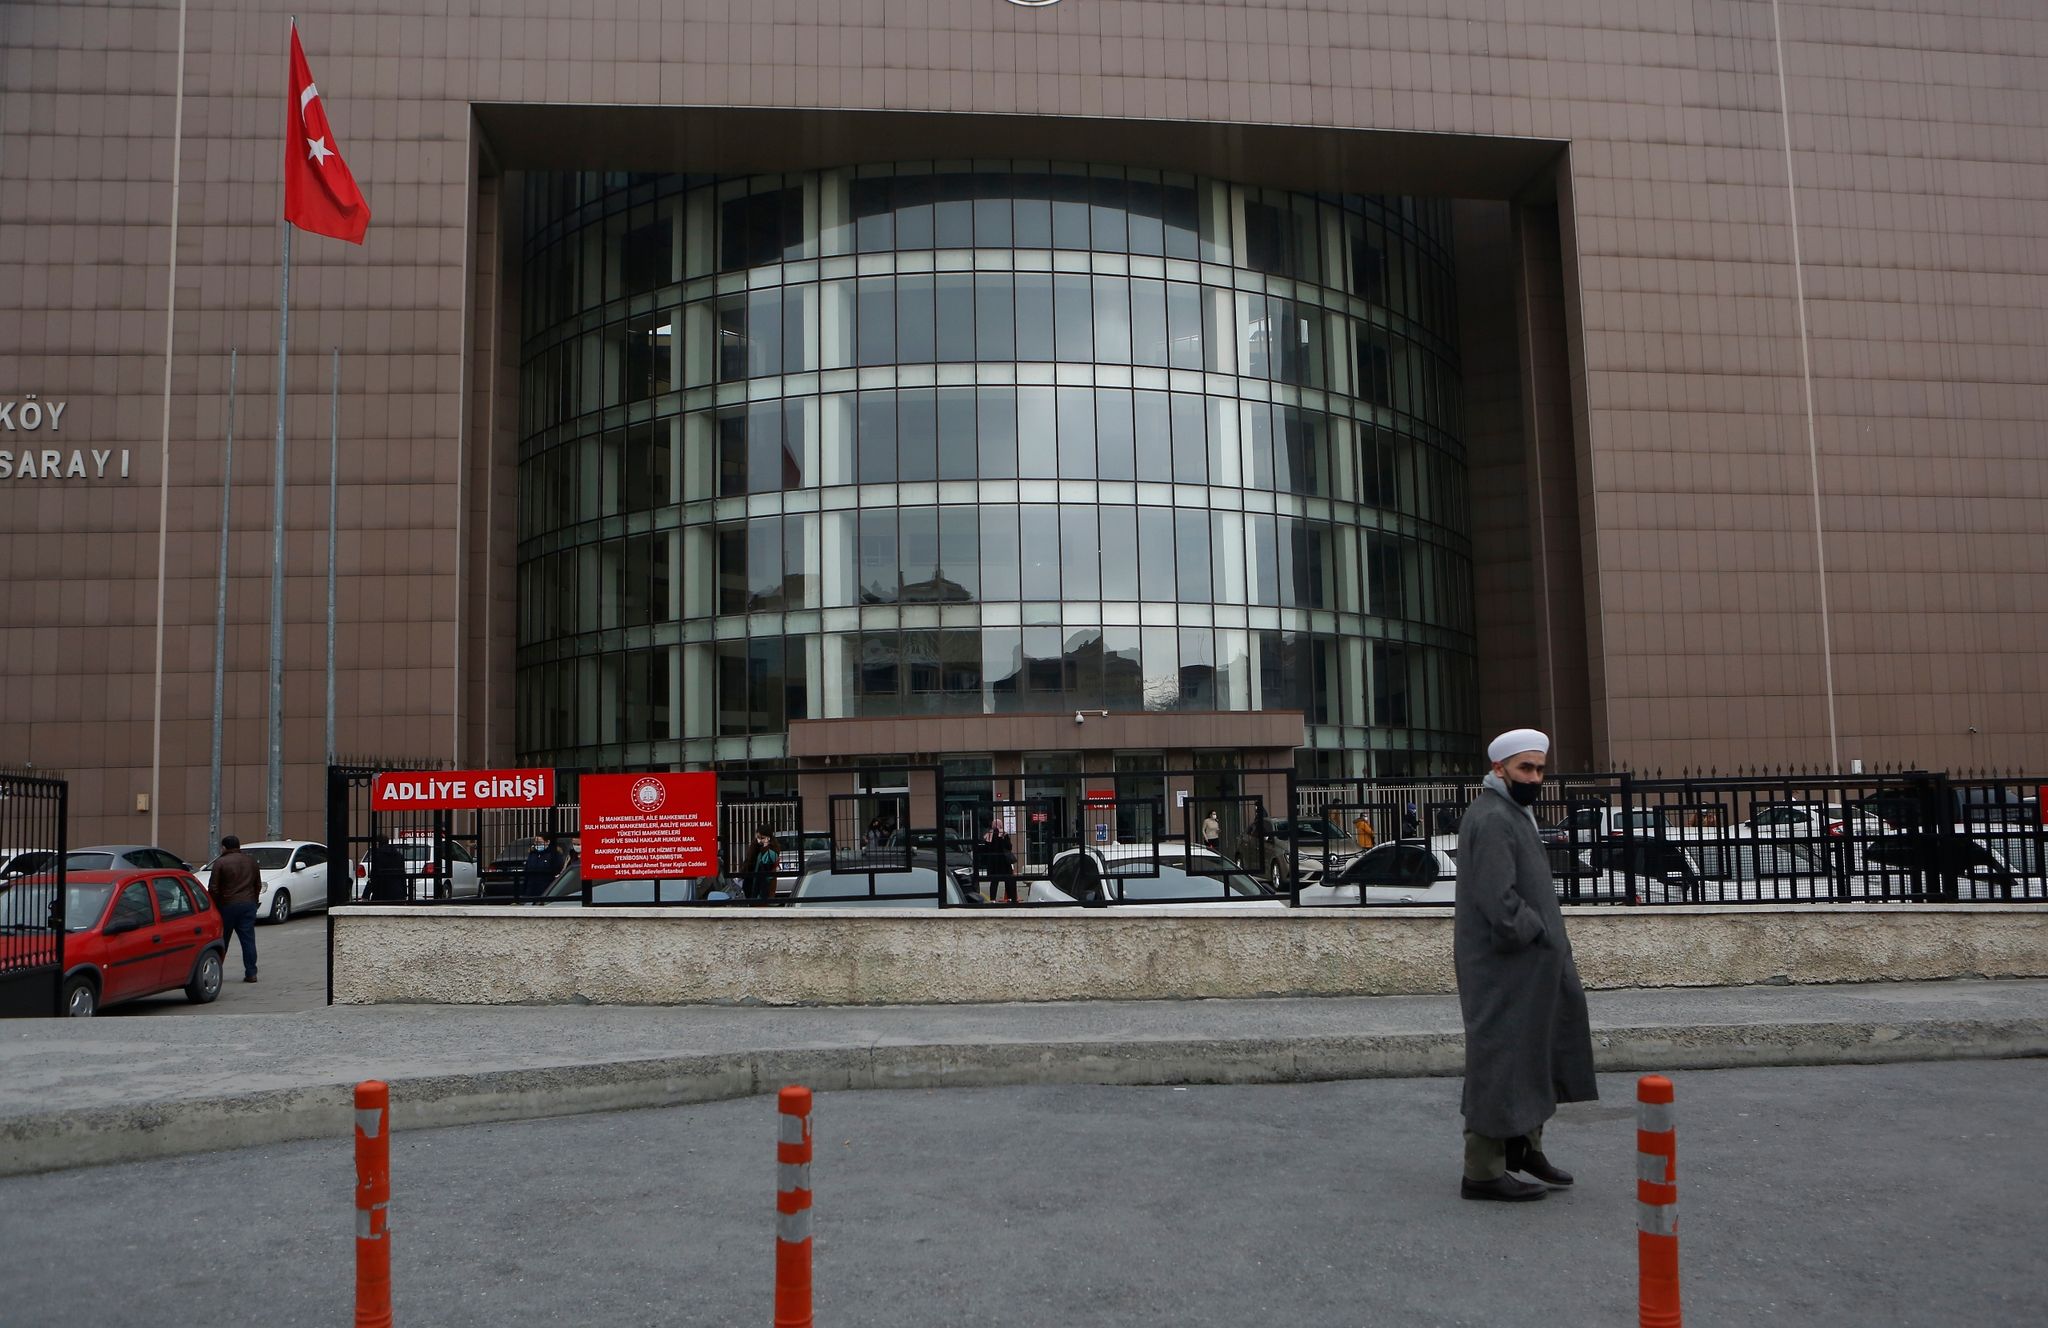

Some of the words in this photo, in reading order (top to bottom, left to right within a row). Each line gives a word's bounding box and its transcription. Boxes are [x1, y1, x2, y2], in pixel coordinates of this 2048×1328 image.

[0, 394, 66, 431] KÖY
[0, 449, 130, 479] SARAYI
[382, 777, 467, 800] ADLİYE
[474, 774, 544, 801] GİRİŞİ
